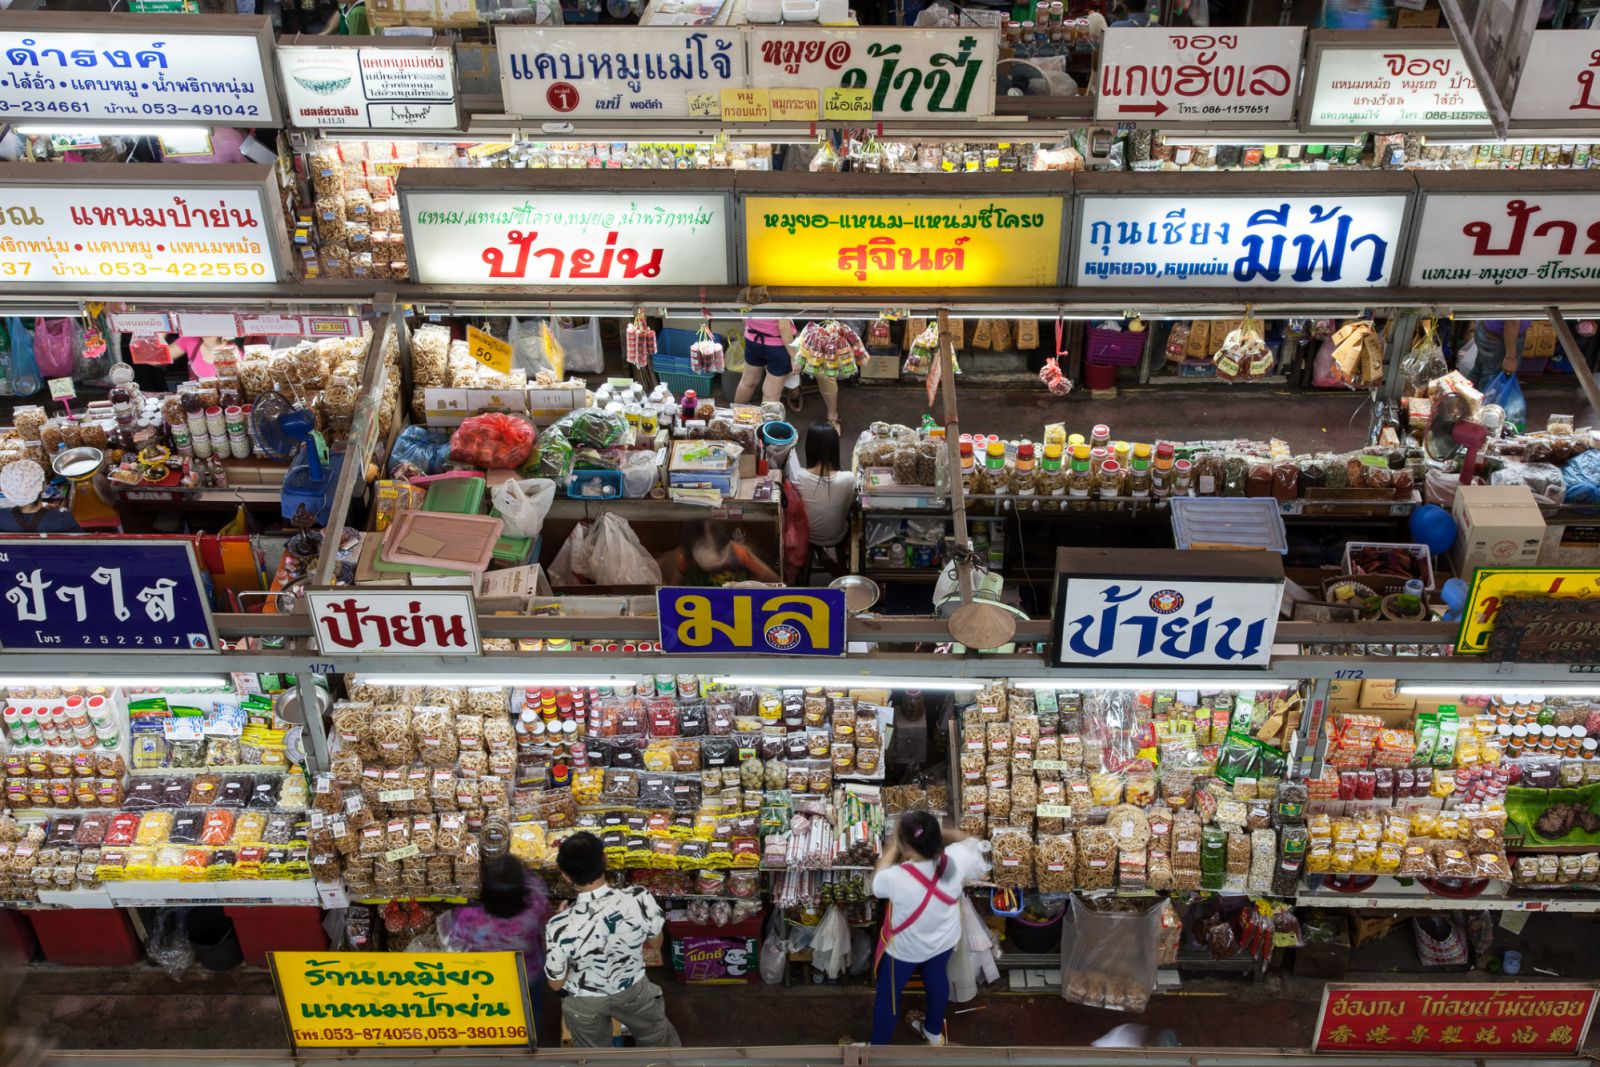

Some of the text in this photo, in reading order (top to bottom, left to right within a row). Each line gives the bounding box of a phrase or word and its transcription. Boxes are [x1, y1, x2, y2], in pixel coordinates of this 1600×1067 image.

[6, 39, 168, 69] ดำรงค์
[1169, 35, 1238, 49] จอย
[510, 33, 732, 93] แคบหมูแม่โจ้
[760, 40, 852, 74] หมูยอ
[1383, 53, 1450, 77] จอย
[8, 71, 255, 99] ไส้อั่ว แคบหมู น้ำพริกหนุ่ม
[1102, 51, 1291, 97] แกงฮังเล
[1331, 77, 1391, 90] แหนมหม้อ
[1401, 79, 1437, 93] หมูยอ
[104, 102, 138, 114] บ้าน
[142, 103, 259, 116] 053-491042
[558, 94, 570, 110] 1
[630, 99, 663, 110] พอดีคำ
[724, 104, 768, 117] กรอบแก้ว
[737, 92, 753, 105] หมู
[771, 98, 817, 114] หมูกระจก
[825, 91, 873, 113] เนื้อเค็ม
[1202, 105, 1269, 114] 086-1157651
[70, 196, 258, 228] แหนมป้าย่น
[87, 240, 152, 260] แคบหมู
[170, 236, 262, 254] แหนมหม้อ
[482, 230, 664, 278] ป้าย่น
[1090, 203, 1389, 283] กุนเชียง มีฟ้า
[838, 236, 971, 281] สุจินต์
[320, 598, 468, 648] ป้าย่น
[1069, 585, 1268, 660] ป้าย่น
[35, 631, 61, 643] โทร
[308, 663, 336, 673] 1/71
[1334, 669, 1364, 679] 1/72
[304, 960, 494, 986] ร้านเหมียว
[301, 991, 510, 1018] แหนมป้าย่น
[1332, 994, 1404, 1016] ฮ่องกง
